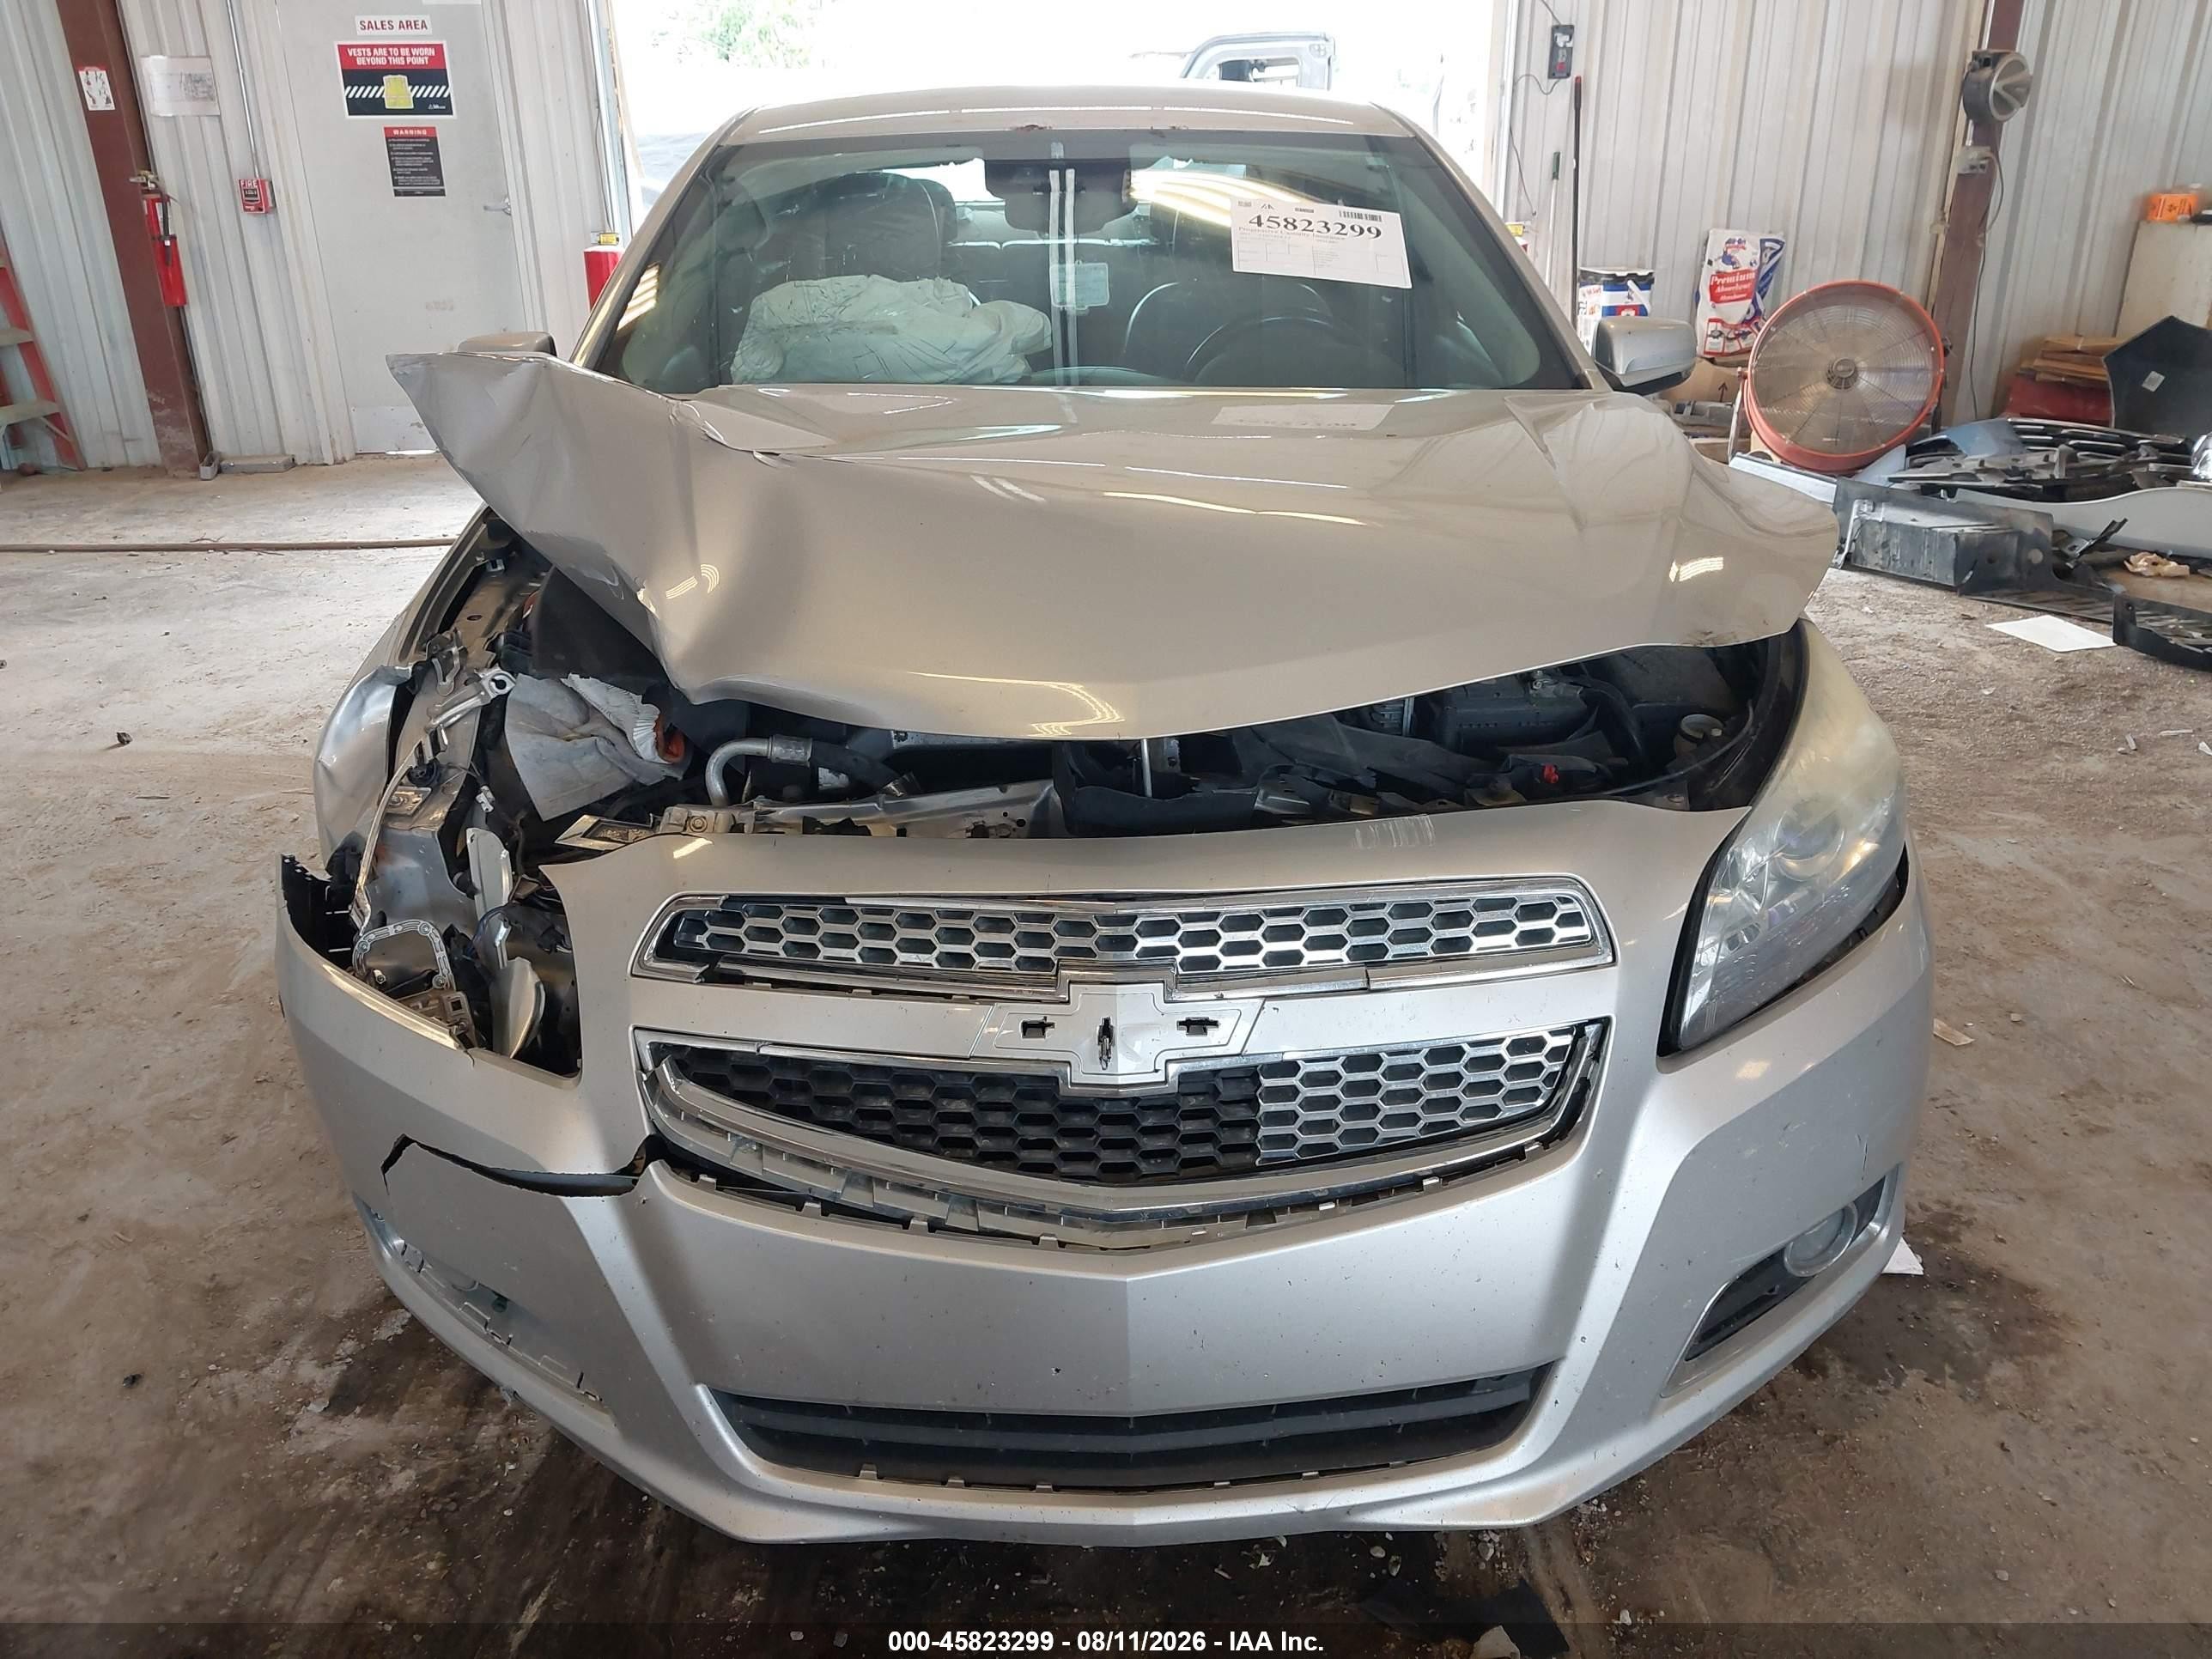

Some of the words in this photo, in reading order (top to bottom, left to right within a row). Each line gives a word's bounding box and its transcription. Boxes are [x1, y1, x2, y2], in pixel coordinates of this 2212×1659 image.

[359, 20, 395, 31] SALES
[398, 20, 428, 30] AREA
[347, 48, 372, 57] VESTS
[373, 48, 389, 57] ARE
[411, 47, 435, 56] WORN
[356, 57, 387, 65] BEYOND
[388, 57, 405, 65] THIS
[406, 56, 429, 64] POINT
[240, 179, 258, 188] FIRE
[1249, 214, 1382, 240] 45823299
[1711, 271, 1756, 286] Premium
